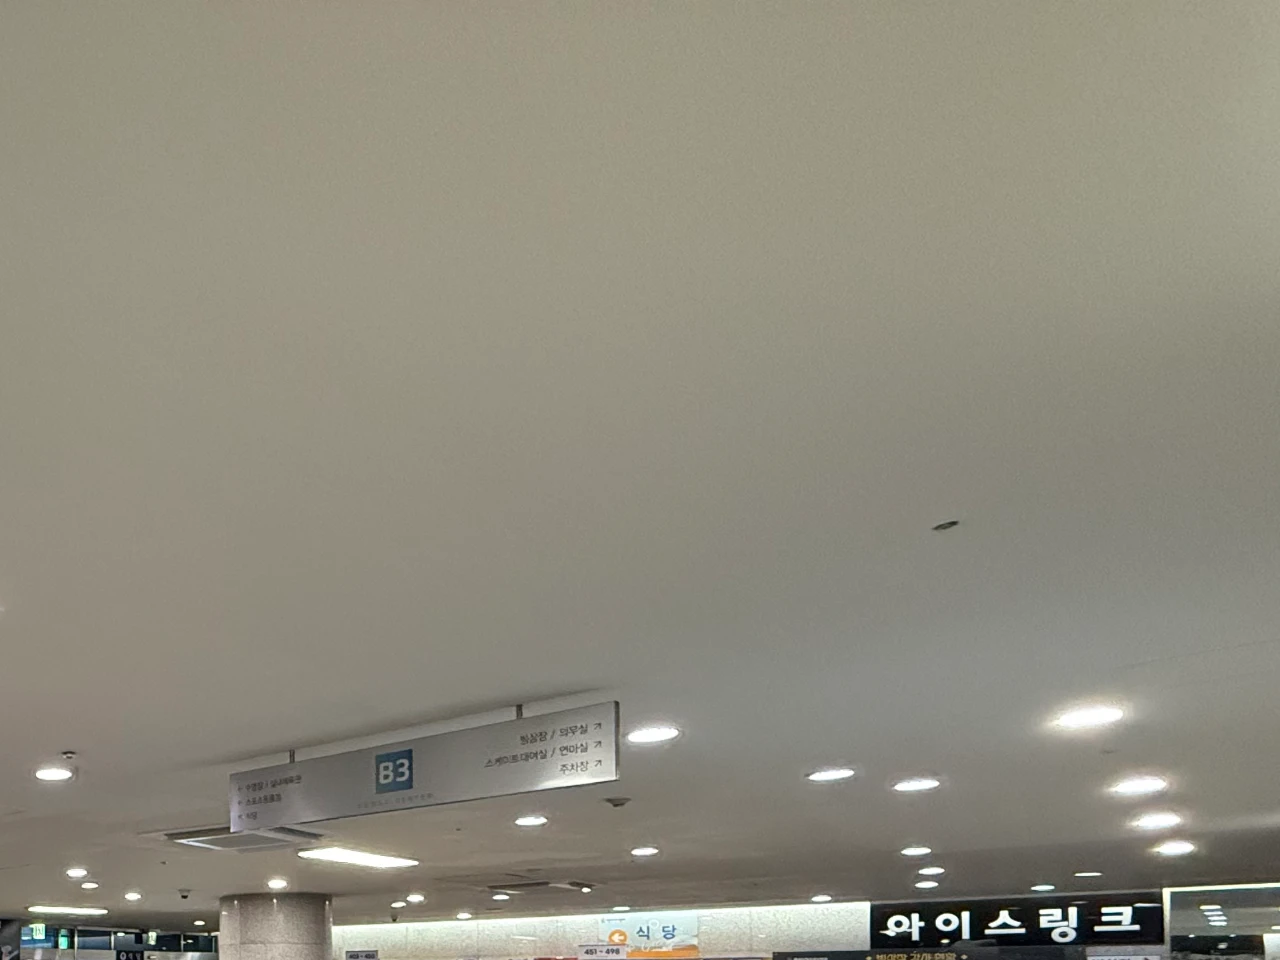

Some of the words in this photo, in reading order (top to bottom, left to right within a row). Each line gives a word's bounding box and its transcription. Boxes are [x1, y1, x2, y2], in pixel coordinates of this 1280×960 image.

[559, 724, 588, 737] 의무실
[379, 758, 410, 784] B3
[559, 760, 589, 775] 주차장
